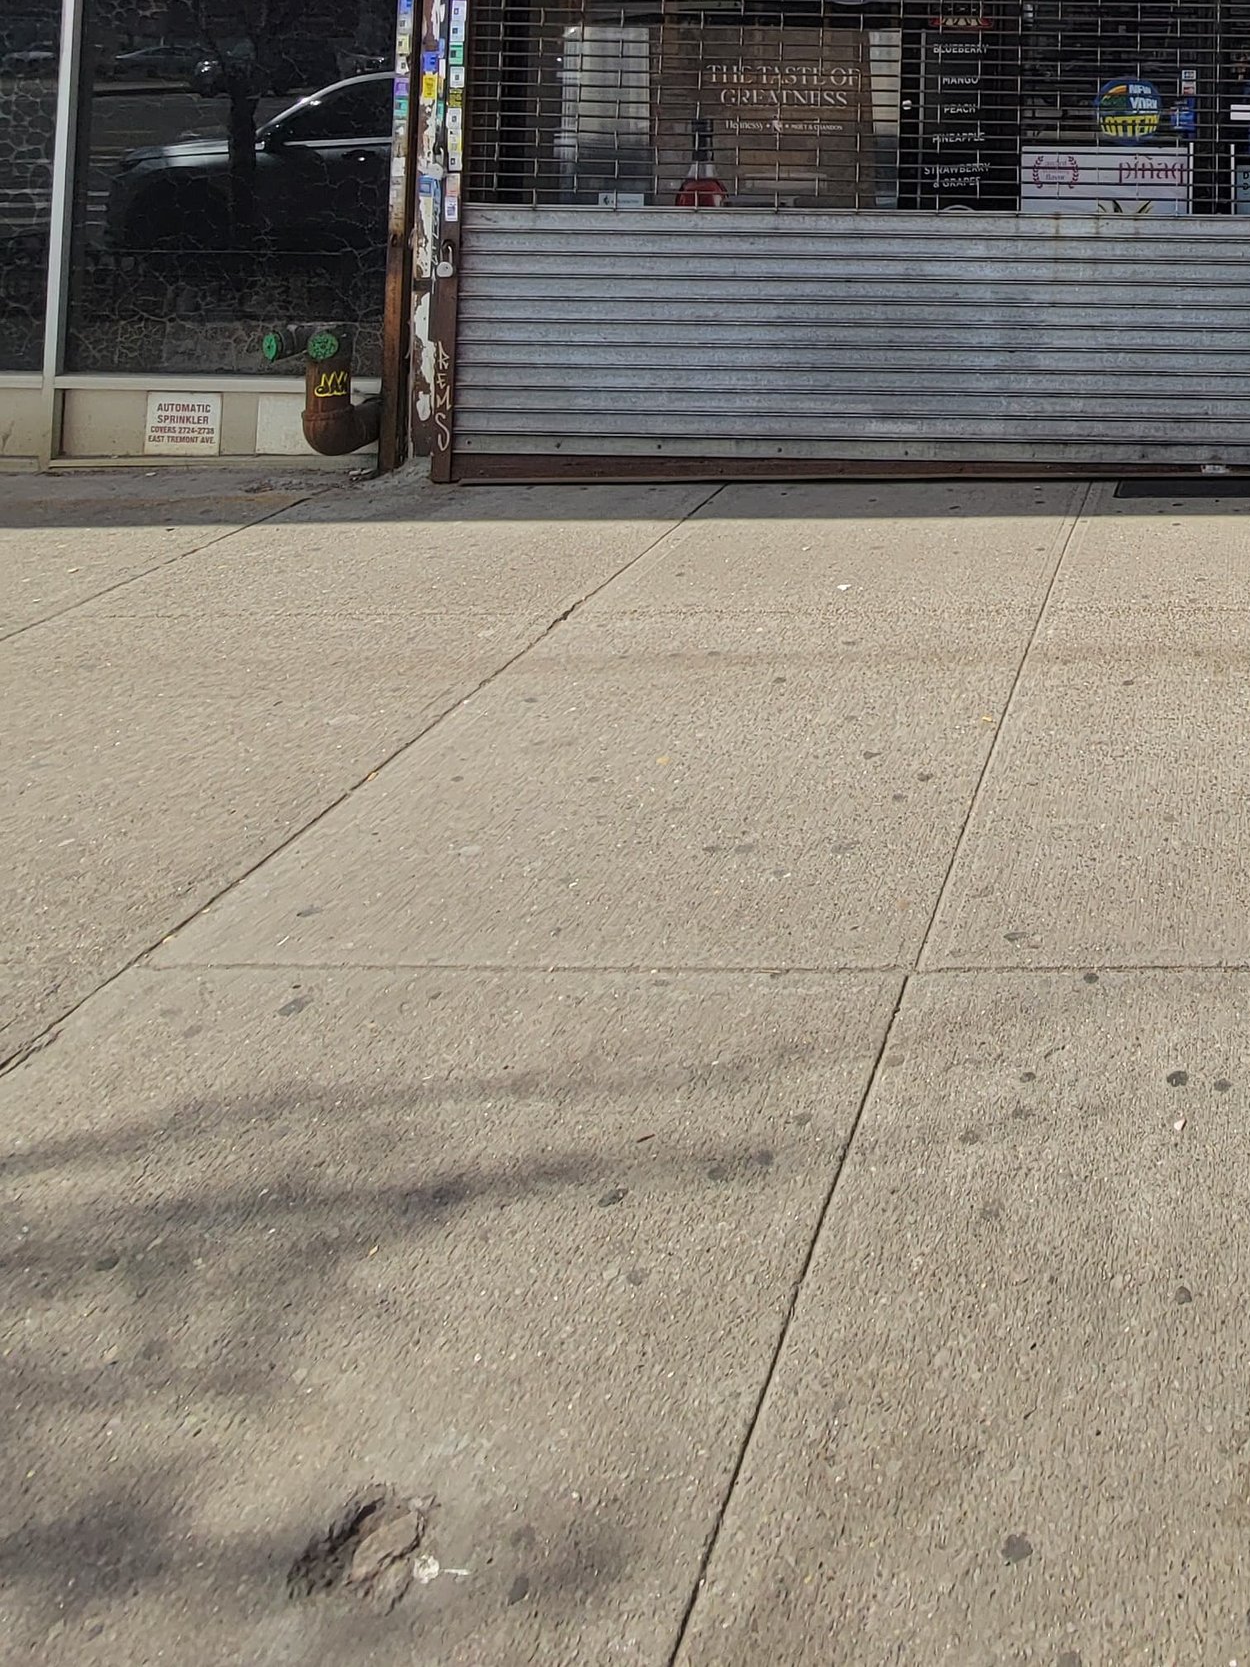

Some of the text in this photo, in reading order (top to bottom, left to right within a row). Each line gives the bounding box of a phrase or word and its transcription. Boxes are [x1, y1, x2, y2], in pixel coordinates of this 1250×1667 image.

[706, 65, 752, 83] THE
[756, 65, 826, 85] TASTE
[720, 89, 848, 109] GREATNESS
[944, 104, 977, 113] PEACH
[157, 403, 211, 413] AUTOMATIC
[157, 415, 209, 425] SPRINKLER
[150, 425, 177, 434] COVERS
[148, 435, 165, 443] EAST
[167, 435, 199, 444] TREMONT
